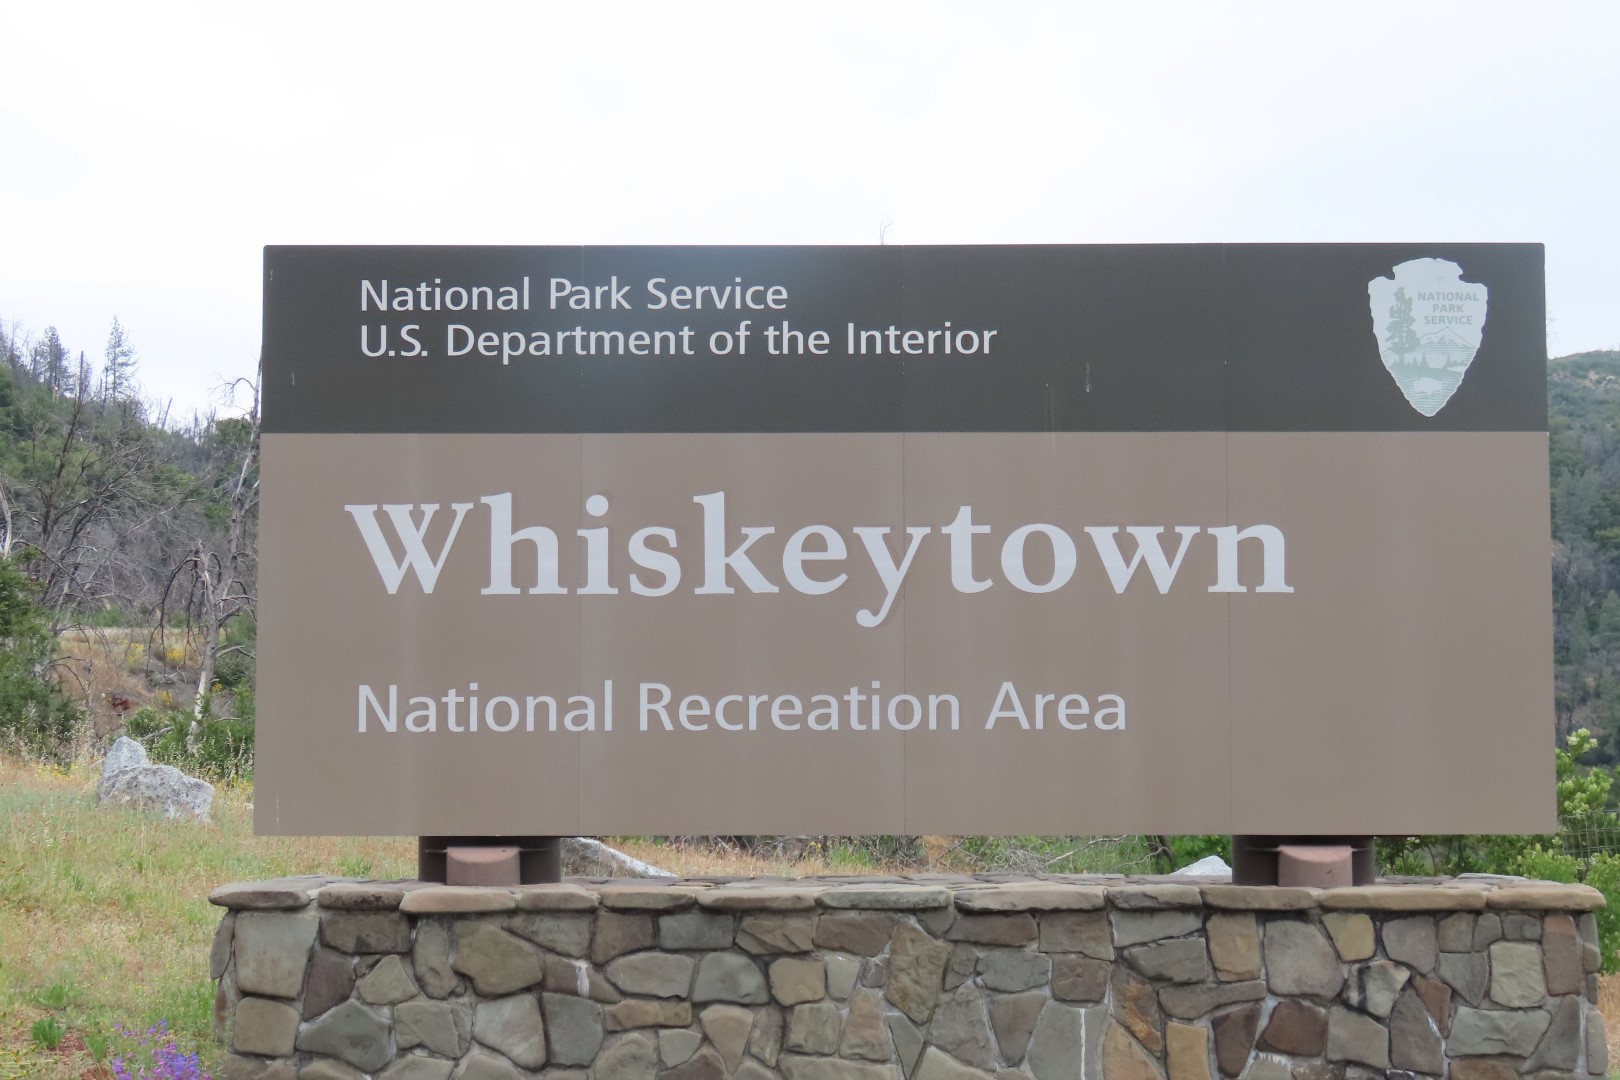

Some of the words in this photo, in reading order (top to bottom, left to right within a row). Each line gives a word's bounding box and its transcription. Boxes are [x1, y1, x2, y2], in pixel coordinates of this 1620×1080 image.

[361, 276, 530, 311] National
[550, 275, 632, 310] Park
[647, 276, 788, 310] Service
[1417, 292, 1480, 302] NATIONAL
[1432, 303, 1464, 313] PARK
[1424, 315, 1473, 325] SERVICE
[361, 324, 428, 358] U.S.
[447, 323, 695, 366] Department
[709, 320, 752, 355] of
[763, 320, 830, 355] the
[847, 321, 998, 355] Interior
[344, 491, 1295, 628] Whiskeytown
[358, 679, 612, 734] National
[639, 680, 960, 732] Recreation
[985, 681, 1127, 731] Area
